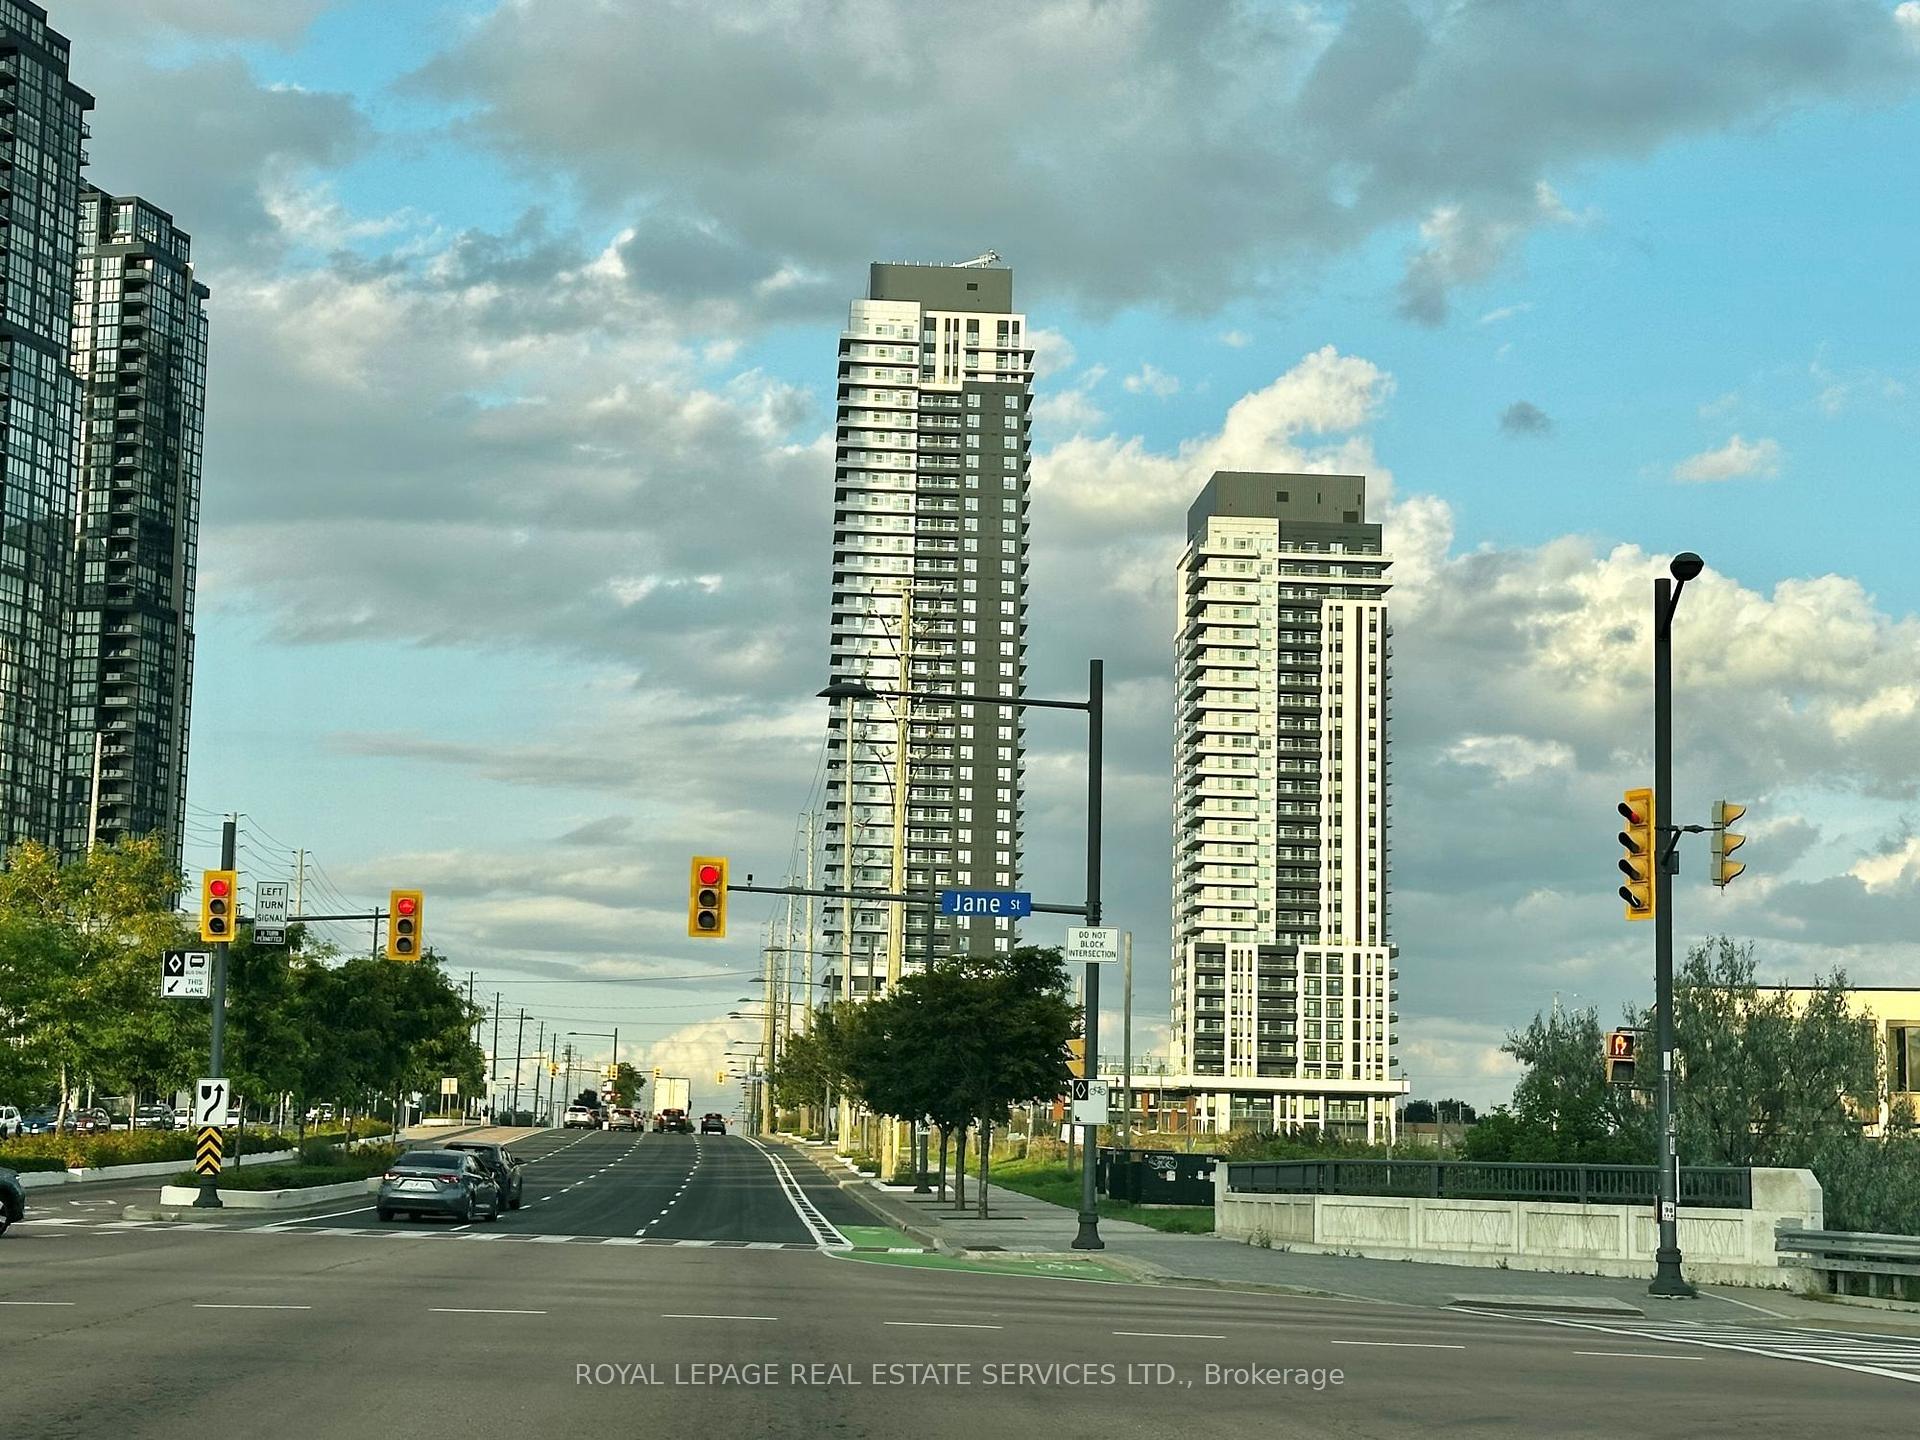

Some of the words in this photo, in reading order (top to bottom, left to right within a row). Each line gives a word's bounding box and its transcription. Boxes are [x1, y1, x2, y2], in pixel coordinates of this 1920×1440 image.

[262, 888, 283, 896] LEFT
[260, 901, 283, 909] TURN
[953, 893, 1001, 913] Jane
[1010, 899, 1021, 910] St
[257, 914, 285, 922] SIGNAL
[1069, 950, 1116, 958] INTERSECTION
